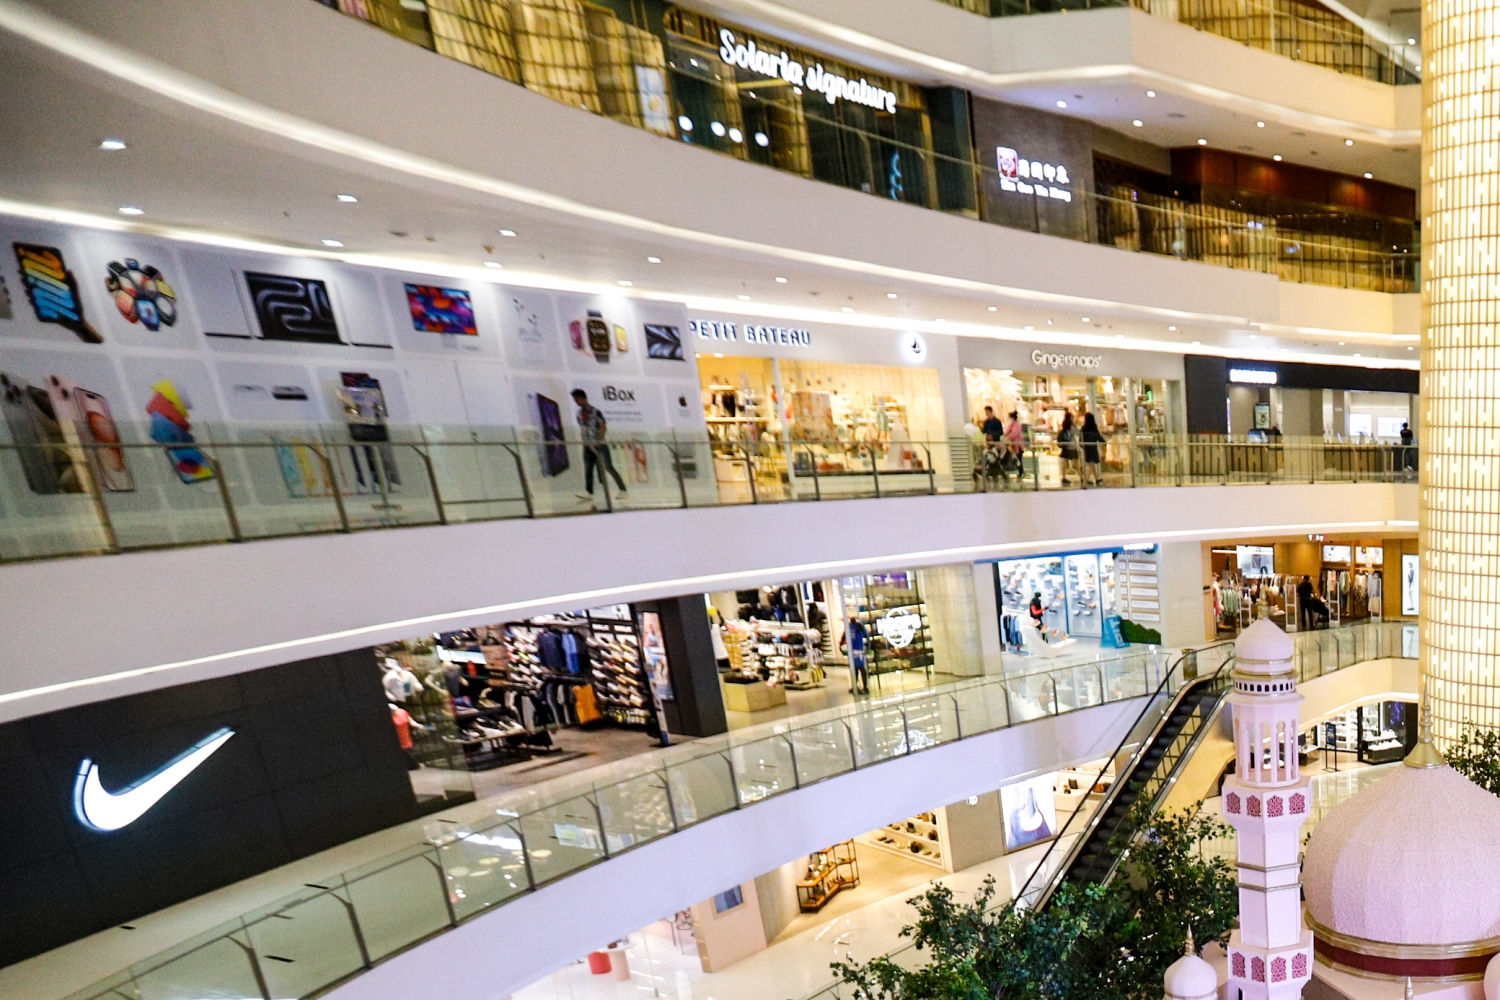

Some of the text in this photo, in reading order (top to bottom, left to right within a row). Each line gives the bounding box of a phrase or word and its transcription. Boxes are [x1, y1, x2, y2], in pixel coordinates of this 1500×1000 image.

[719, 28, 897, 114] Solaria signature
[744, 323, 811, 348] BATEAU
[602, 385, 636, 402] iBox
